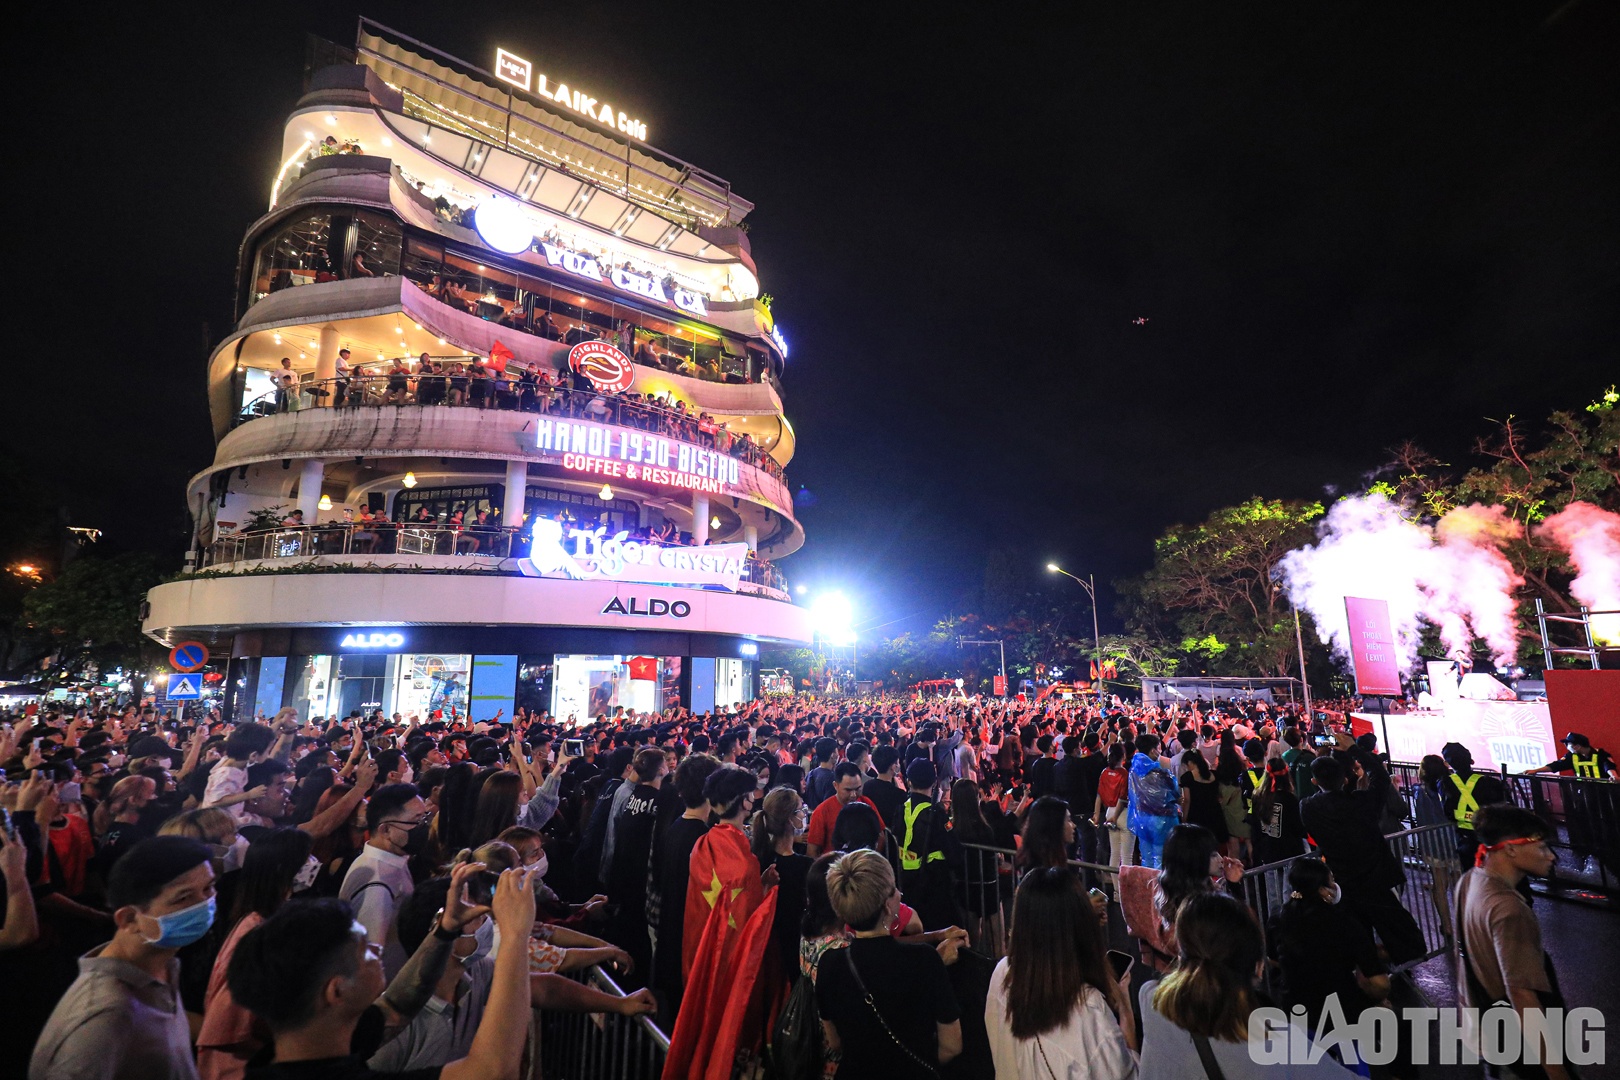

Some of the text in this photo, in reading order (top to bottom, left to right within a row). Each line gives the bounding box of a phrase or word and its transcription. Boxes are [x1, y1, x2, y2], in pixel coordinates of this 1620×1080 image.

[538, 73, 616, 129] LAIKA
[542, 242, 603, 282] VUA
[573, 343, 631, 373] HIGHLANDS
[536, 419, 739, 485] HANOI 1930 BISTRO
[563, 452, 726, 495] COFFEE & RESTAURANT
[568, 526, 750, 576] Tiger CRYSTAL
[602, 596, 691, 618] ALDO
[340, 633, 404, 648] ALDO
[1492, 742, 1543, 769] BIA VIỆT
